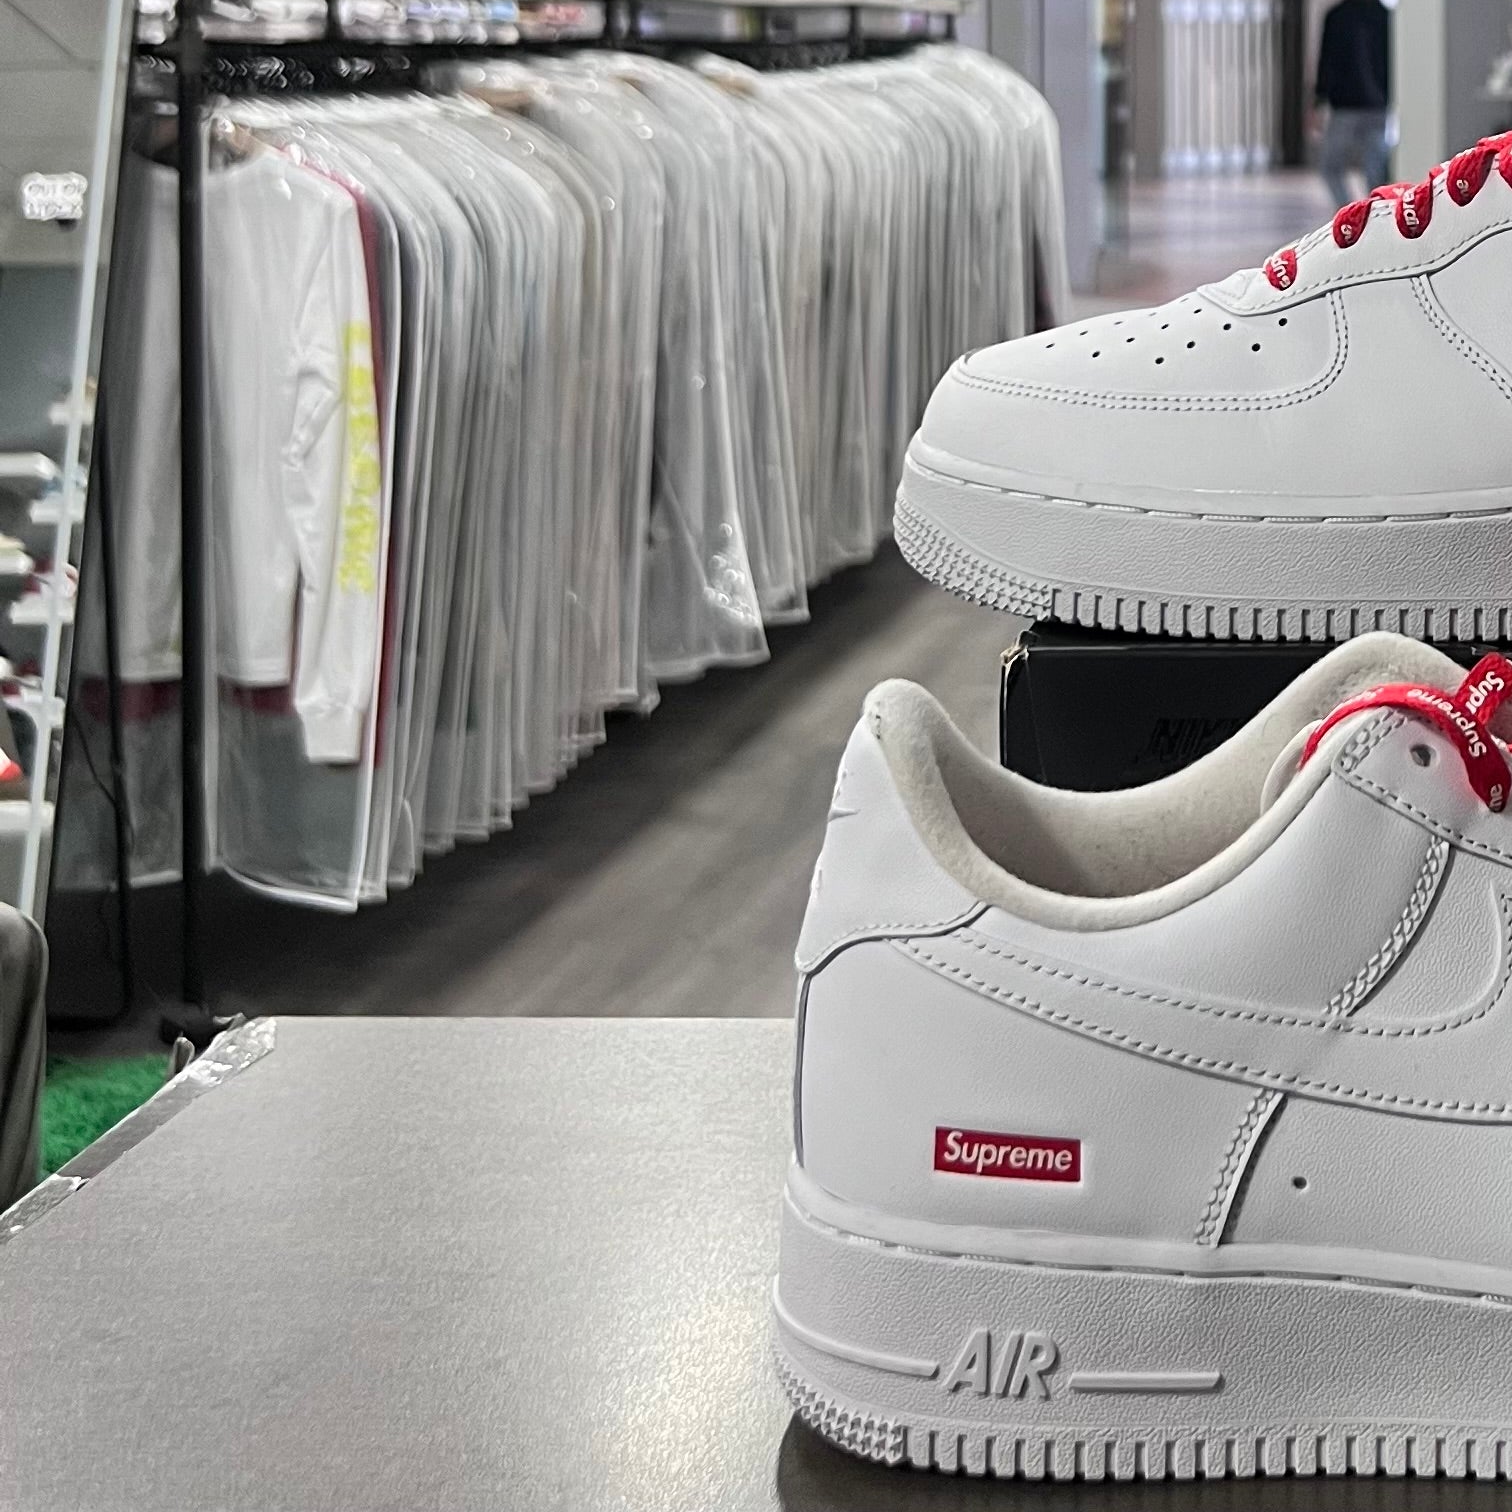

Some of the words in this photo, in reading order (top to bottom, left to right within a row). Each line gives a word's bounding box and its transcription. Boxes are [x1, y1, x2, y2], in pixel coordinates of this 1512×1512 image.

[1146, 717, 1242, 758] NIK
[1407, 688, 1487, 758] Supreme
[944, 1129, 1073, 1173] Supreme
[943, 1327, 1061, 1400] AIR
